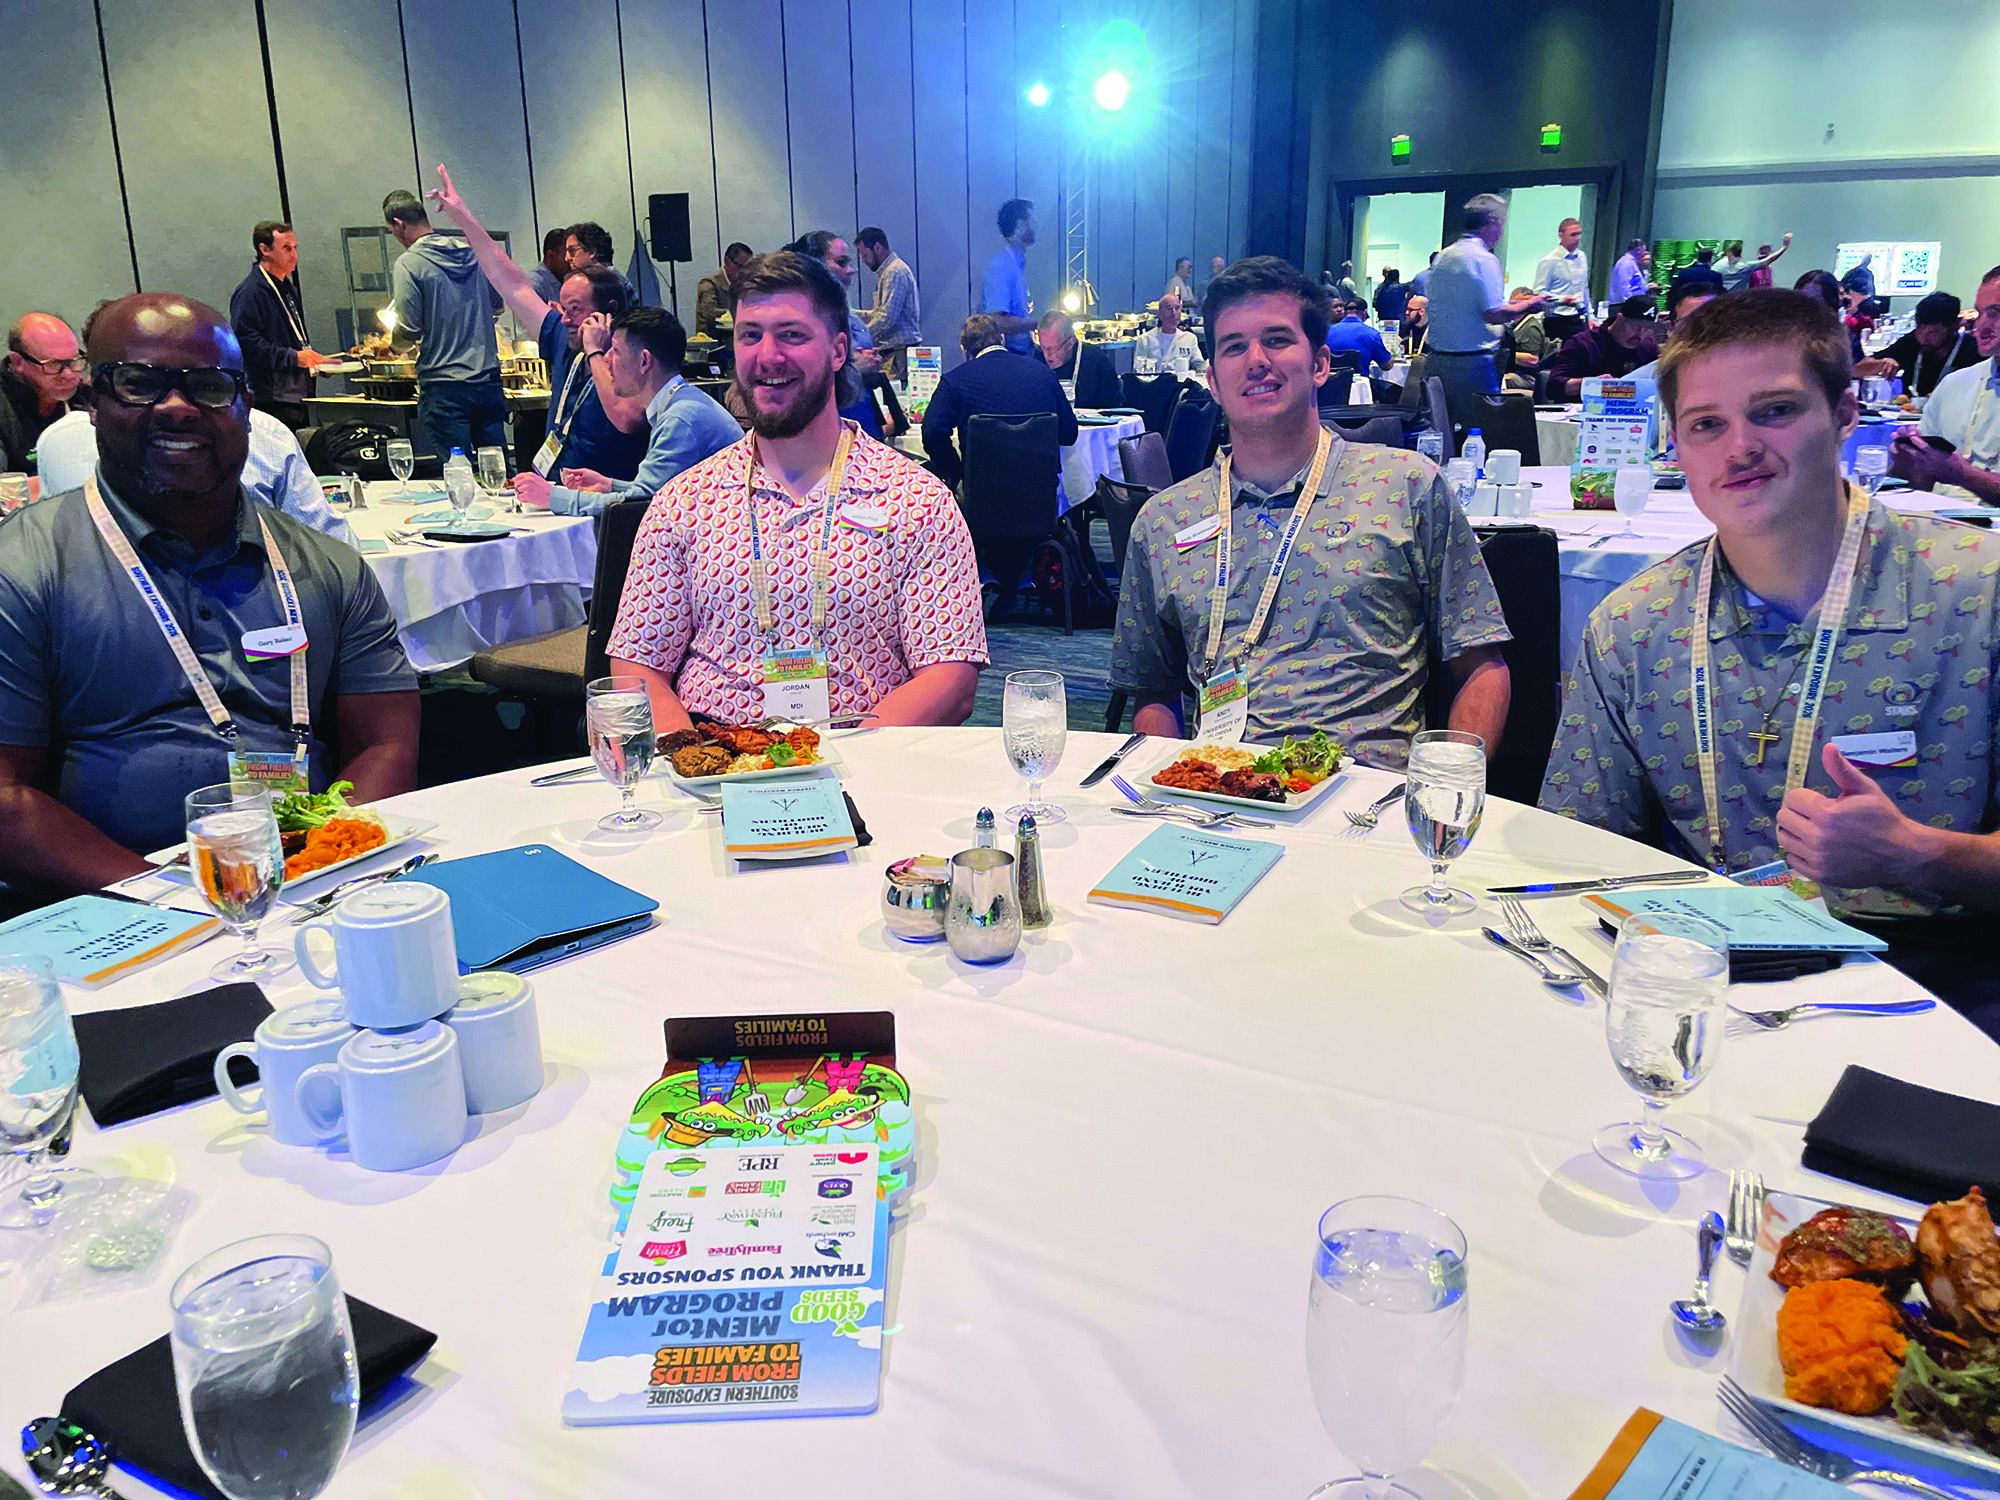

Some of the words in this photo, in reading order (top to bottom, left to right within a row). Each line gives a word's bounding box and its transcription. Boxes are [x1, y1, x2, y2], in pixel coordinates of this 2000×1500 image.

[1815, 629, 1833, 667] SOUTHERN
[1695, 667, 1705, 682] 2026
[782, 683, 810, 692] JORDAN
[1806, 666, 1824, 704] EXPOSURE
[1696, 684, 1707, 717] EXPOSURE
[1217, 707, 1231, 718] ANDY
[1802, 703, 1816, 719] 2026
[1203, 720, 1233, 735] UNIVERSITY
[1234, 716, 1242, 724] OF
[1208, 727, 1232, 738] FLORIDA
[1698, 717, 1709, 753] SOUTHERN
[734, 1019, 805, 1034] FAMILIES
[807, 1019, 827, 1031] TO
[735, 1034, 783, 1047] FIELDS
[786, 1032, 828, 1046] FROM
[738, 1157, 780, 1171] RPE
[647, 1210, 694, 1233] Frey
[805, 1231, 837, 1239] orchards
[645, 1246, 681, 1258] Fresh
[707, 1244, 782, 1256] FamilyTree
[617, 1267, 734, 1286] SPONSORS
[740, 1266, 787, 1281] YOU
[788, 1263, 866, 1279] THANK
[607, 1290, 784, 1318] PROGRAM
[799, 1289, 860, 1303] SEEDS
[791, 1303, 866, 1323] GOOD
[651, 1315, 782, 1338] MENtor
[655, 1345, 769, 1367] FAMILIES
[771, 1343, 801, 1360] TO
[650, 1364, 730, 1385] FIELDS
[732, 1362, 800, 1382] FROM
[650, 1387, 722, 1405] EXPOSURE
[724, 1386, 798, 1402] SOUTHERN
